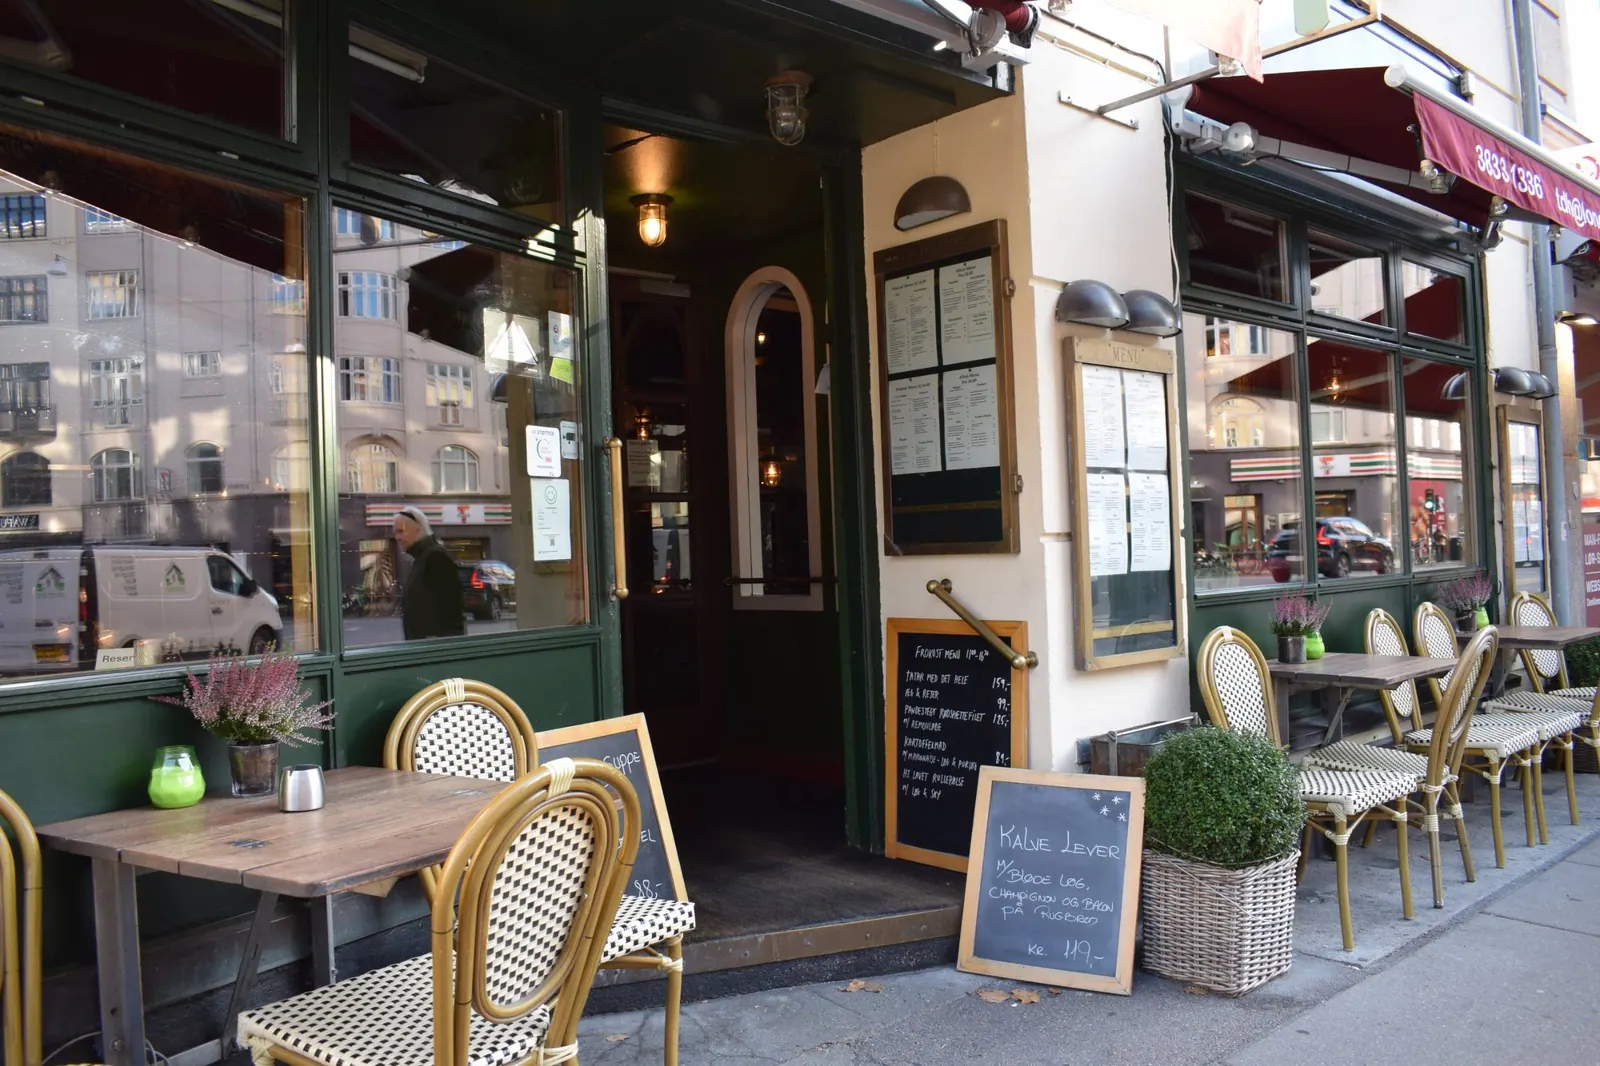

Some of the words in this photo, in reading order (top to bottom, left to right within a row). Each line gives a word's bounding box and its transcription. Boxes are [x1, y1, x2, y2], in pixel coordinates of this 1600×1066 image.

[1112, 345, 1140, 365] MENU
[944, 649, 961, 660] MENU
[926, 673, 938, 683] MED
[940, 674, 951, 684] DET
[1000, 824, 1051, 852] KALVE
[1060, 830, 1120, 860] LEVER
[1082, 897, 1115, 912] BACON
